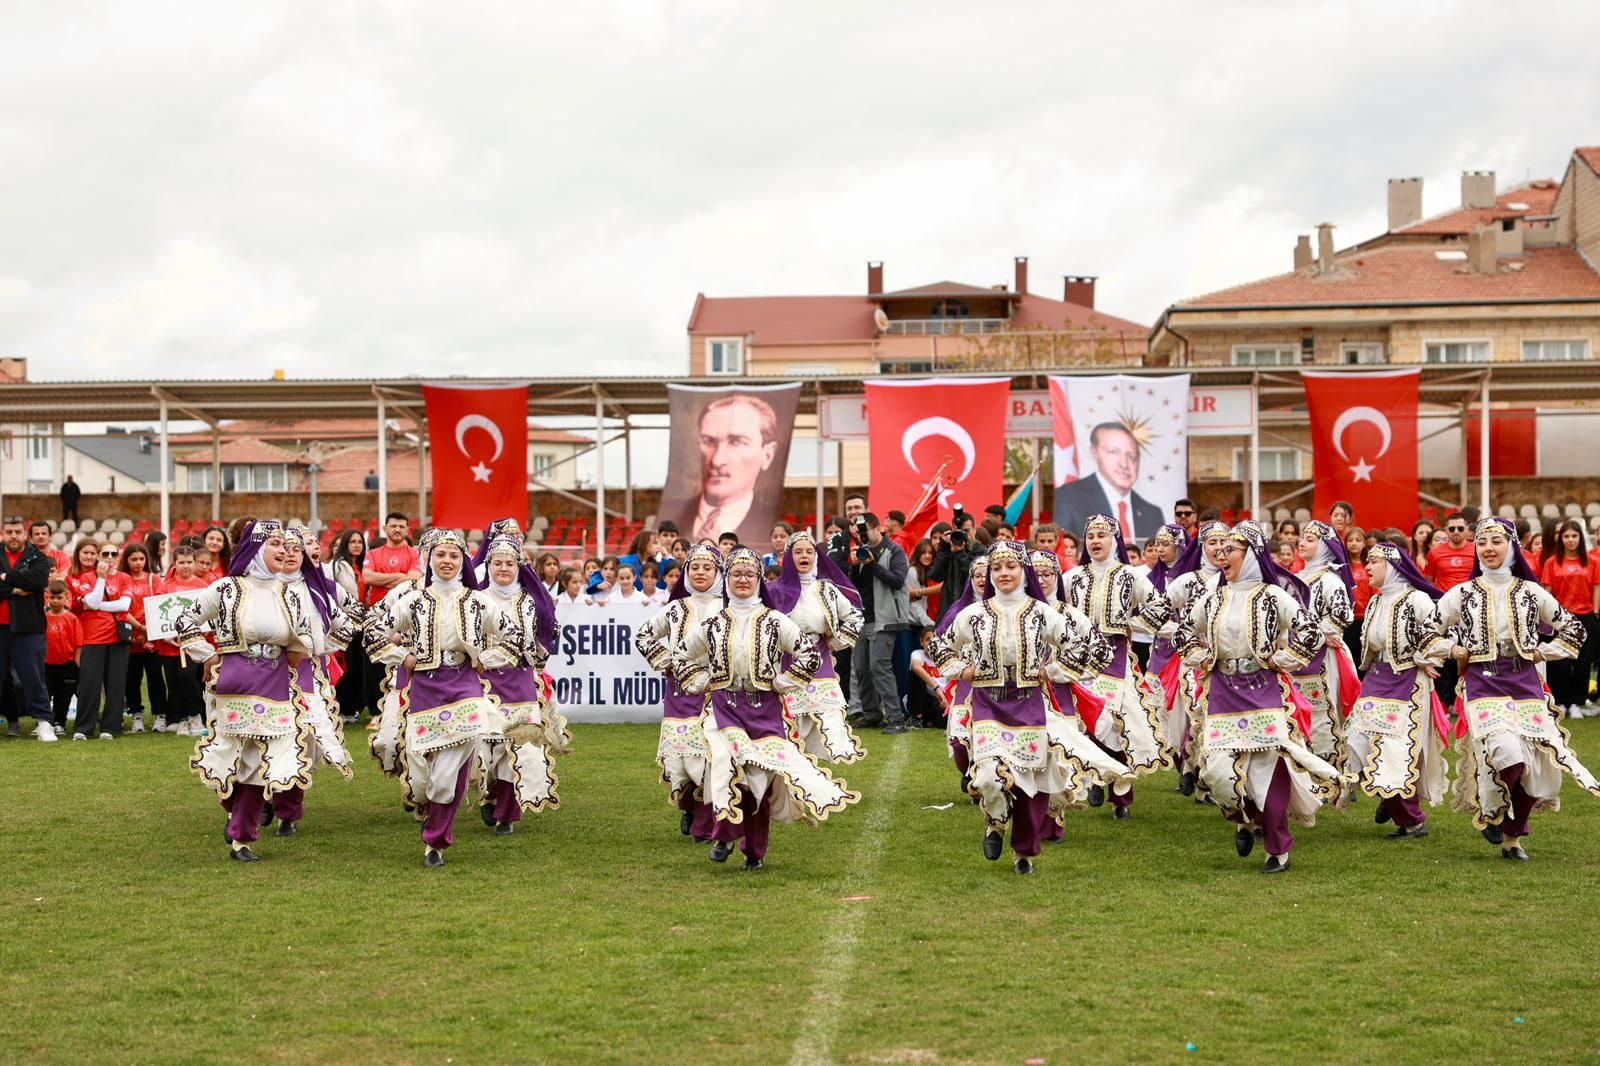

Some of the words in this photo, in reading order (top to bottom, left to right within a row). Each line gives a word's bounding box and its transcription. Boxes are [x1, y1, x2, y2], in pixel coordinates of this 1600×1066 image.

[1013, 400, 1052, 416] BA
[551, 677, 582, 704] OR
[589, 671, 606, 705] İL
